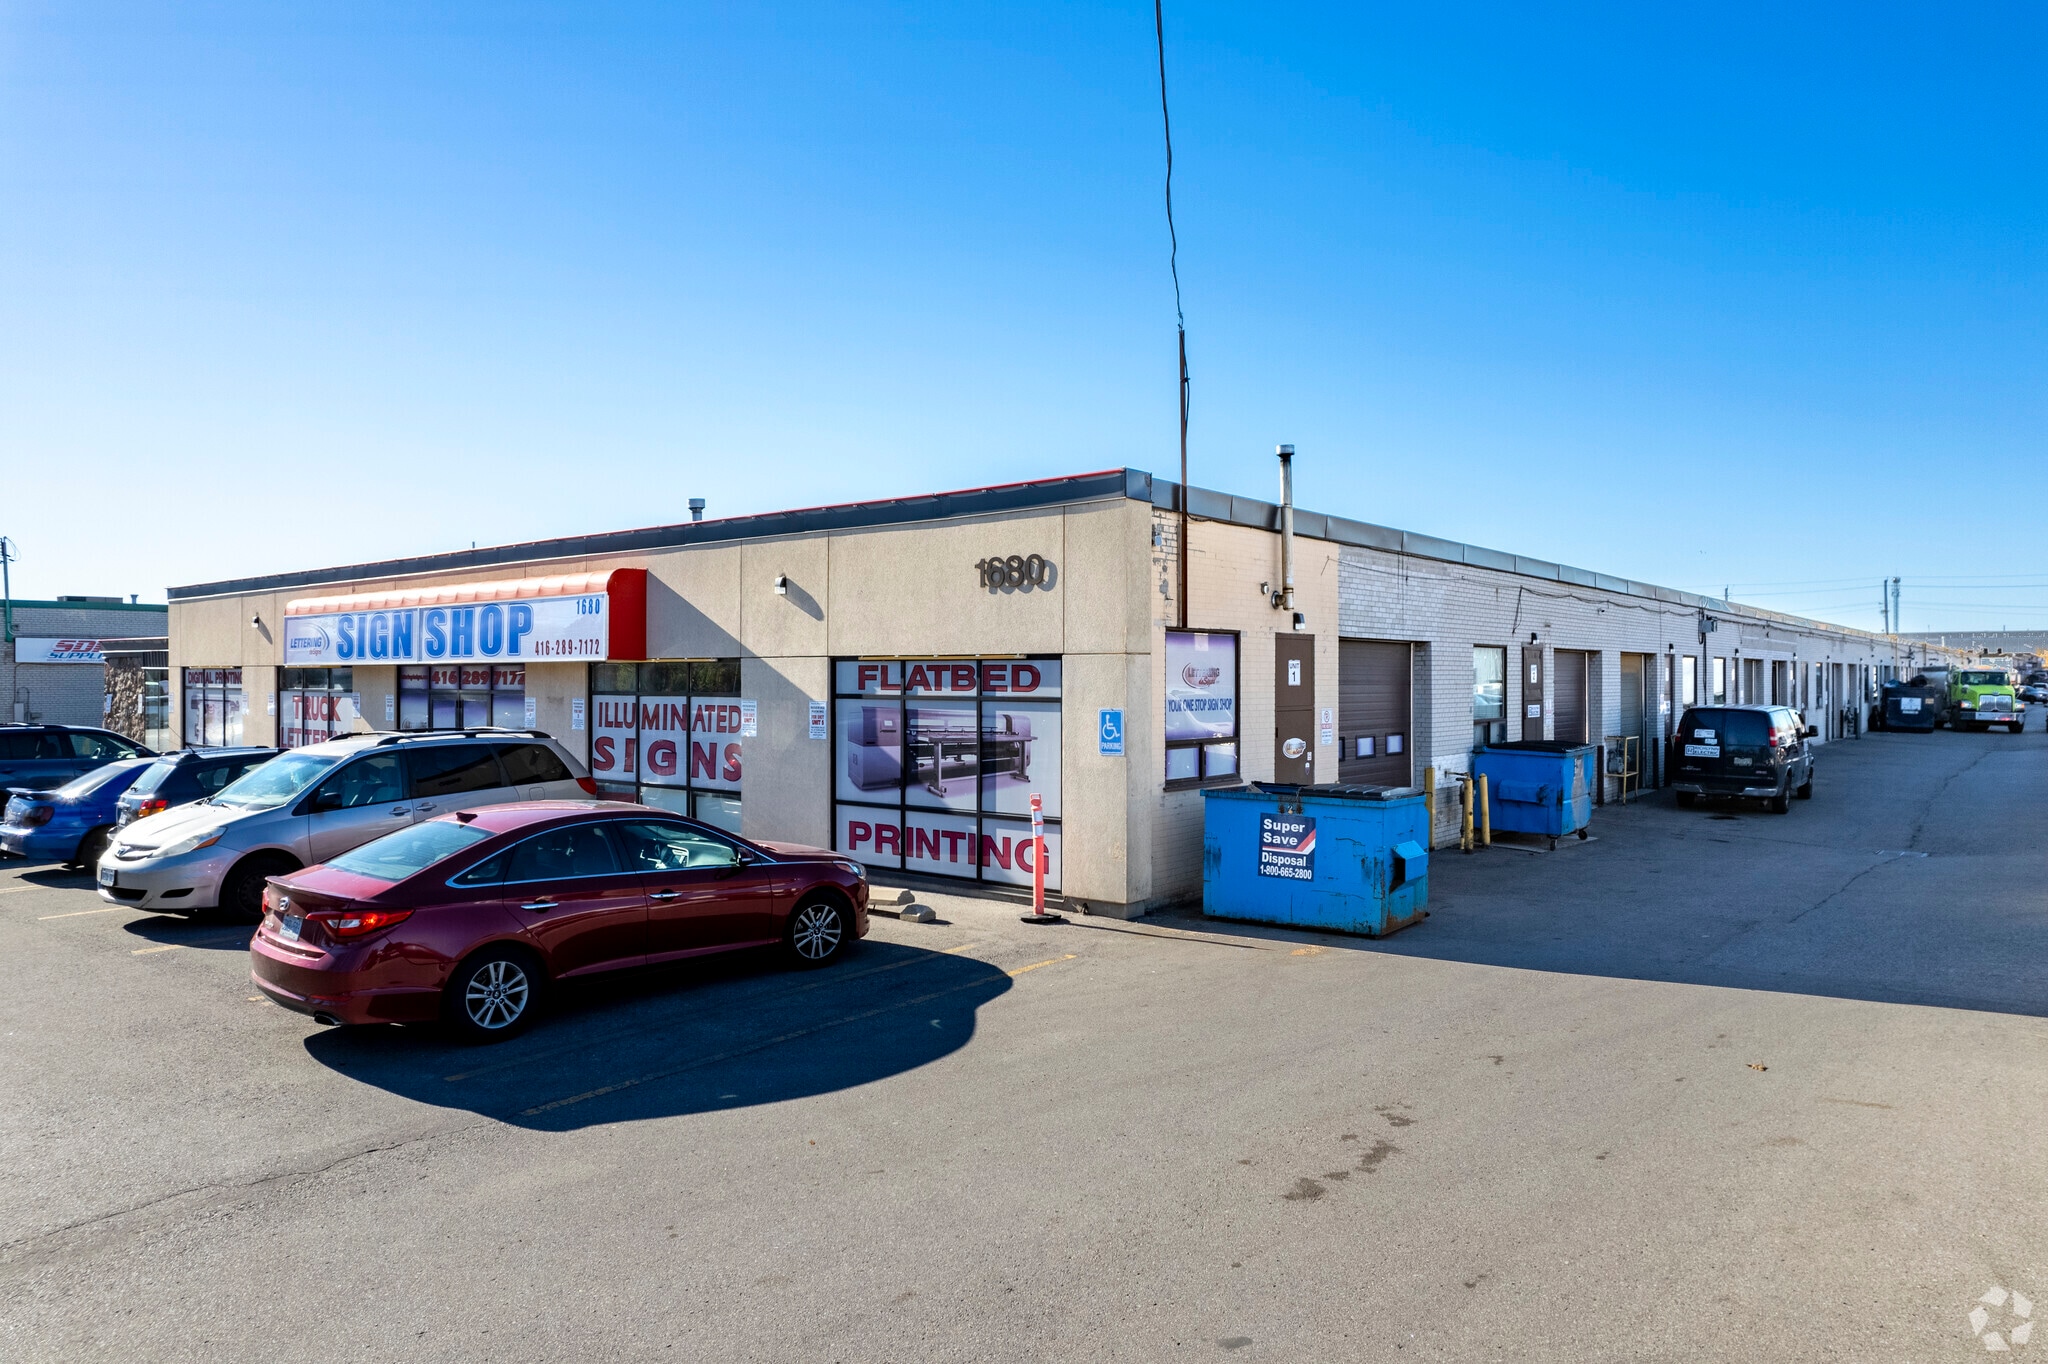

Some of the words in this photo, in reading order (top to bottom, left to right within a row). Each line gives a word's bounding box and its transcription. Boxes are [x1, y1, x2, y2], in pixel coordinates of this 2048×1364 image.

[975, 554, 1044, 588] 1680
[577, 599, 600, 615] 1680
[337, 611, 413, 661] SIGN
[425, 604, 534, 658] SHOP
[290, 637, 322, 648] LETTERING
[535, 639, 600, 655] 416-289-7172
[215, 672, 242, 685] PRNTING
[432, 671, 458, 685] 416
[462, 671, 489, 685] 289
[858, 665, 1041, 692] FLATBED
[1292, 671, 1297, 682] 1
[292, 695, 342, 722] TRUCK
[1167, 699, 1182, 712] YOUR
[1182, 699, 1194, 711] ONE
[1195, 698, 1207, 711] STOP
[1208, 698, 1220, 711] SIGN
[1220, 698, 1233, 711] SHOP
[599, 702, 741, 733] ILLUMINATED
[281, 726, 344, 749] LETTER
[1101, 742, 1122, 750] PARKING
[593, 736, 741, 782] SIGNS
[1263, 818, 1306, 833] Super
[1263, 832, 1298, 846] Save
[849, 820, 1050, 875] PRINTING
[1261, 851, 1307, 867] Disposal
[1260, 864, 1312, 880] 1-800-665-2800
